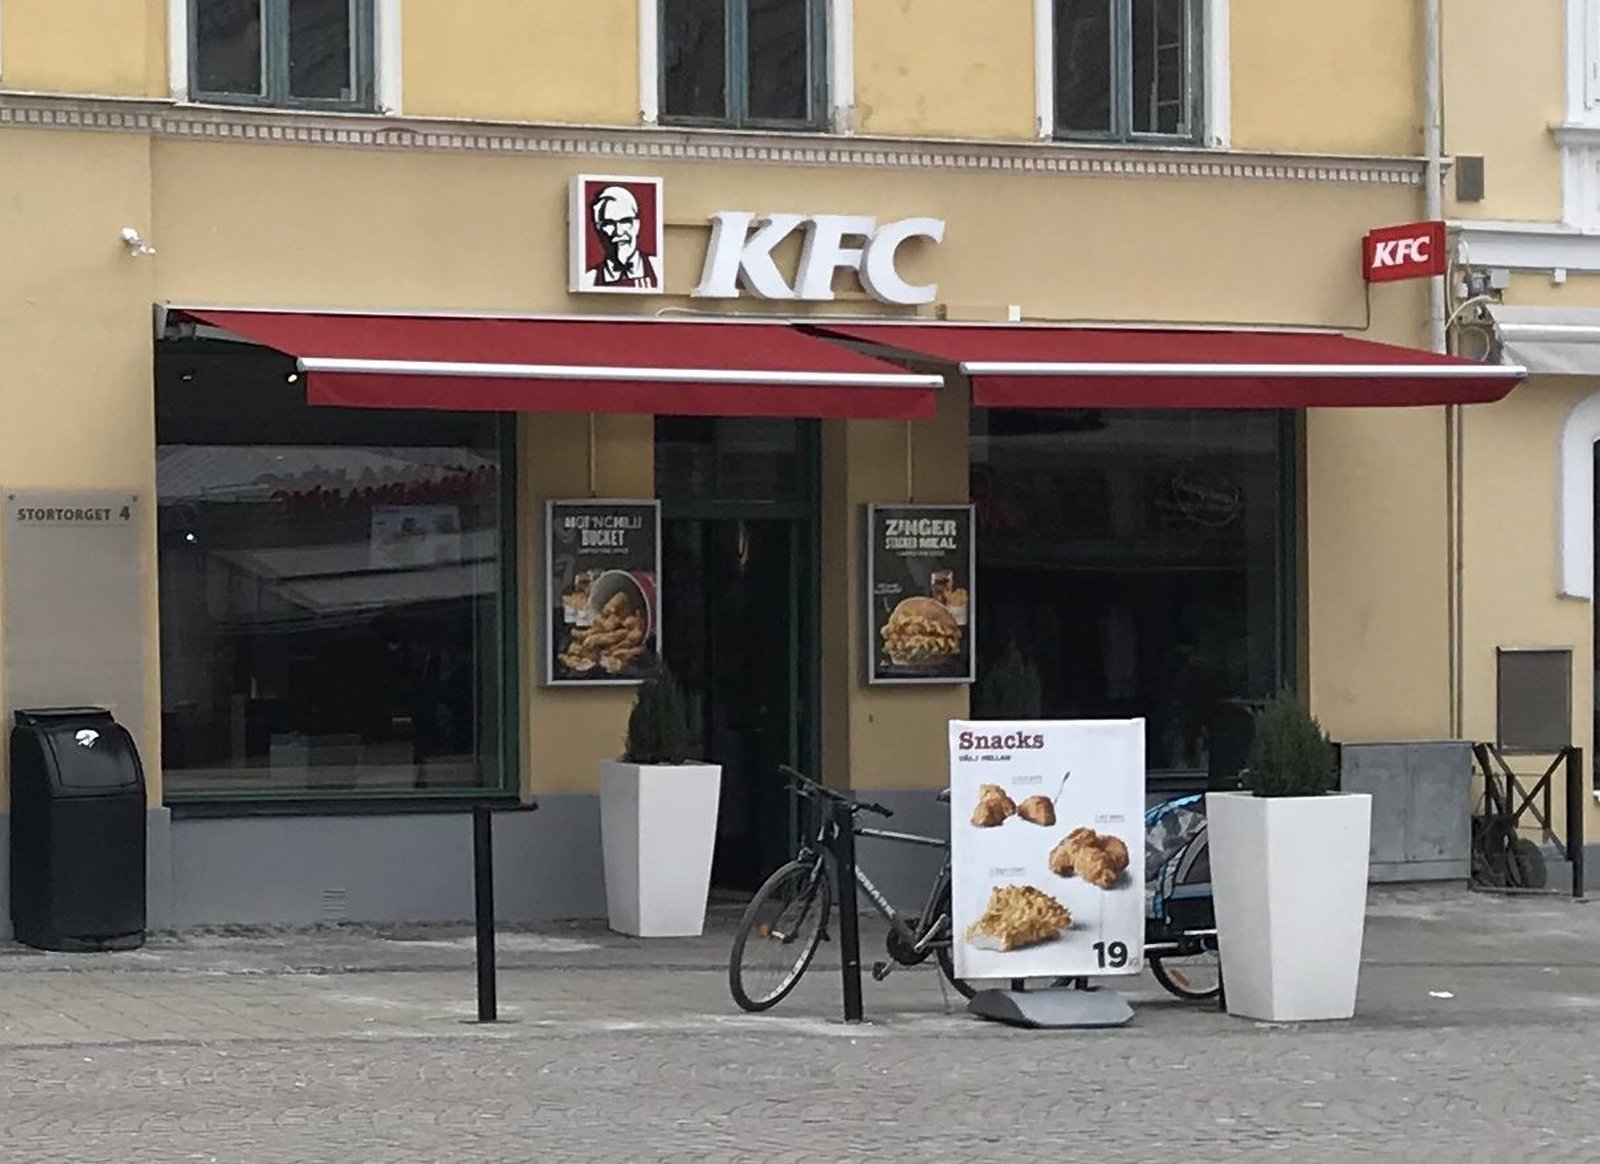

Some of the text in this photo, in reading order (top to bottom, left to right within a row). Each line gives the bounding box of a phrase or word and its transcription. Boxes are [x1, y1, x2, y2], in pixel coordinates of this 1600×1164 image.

[690, 211, 945, 305] KFC
[1372, 236, 1431, 268] KFC
[17, 506, 130, 521] STORTORGET 4
[885, 518, 957, 536] ZINGER
[919, 537, 957, 549] MEAL
[958, 731, 1045, 750] Snacks
[1092, 941, 1129, 969] 19
